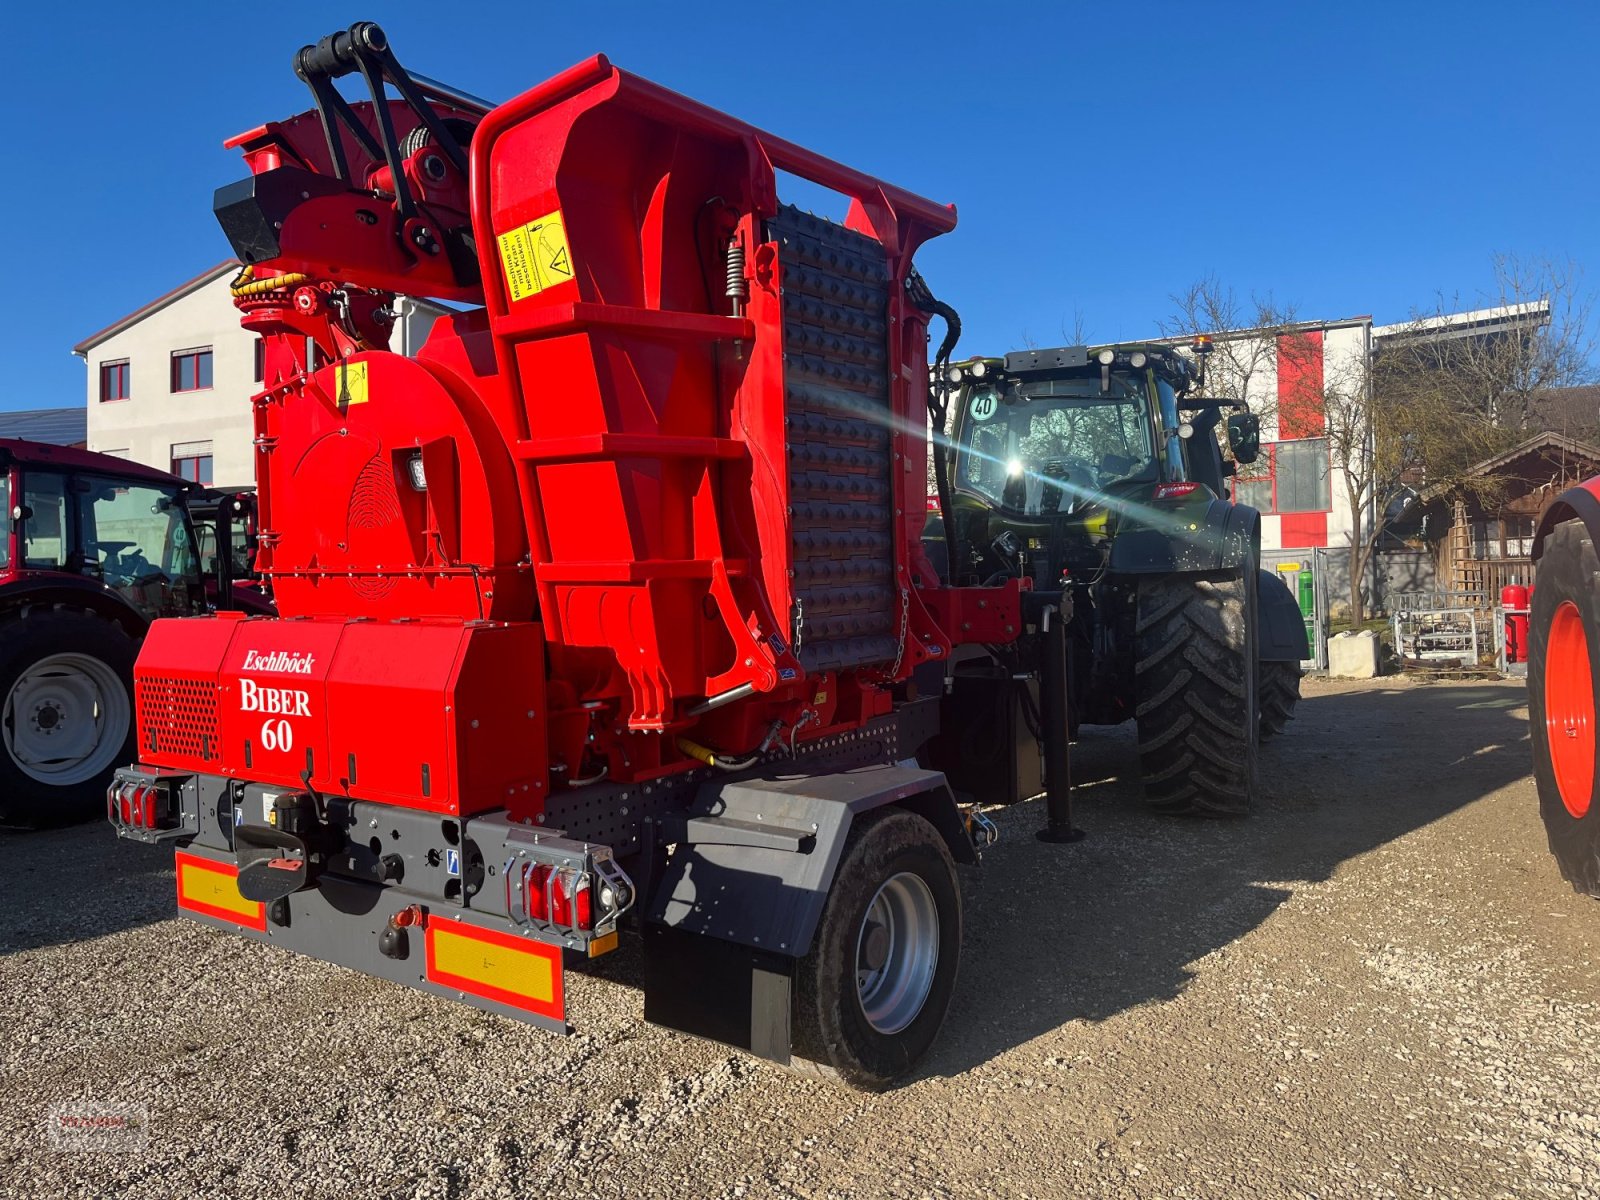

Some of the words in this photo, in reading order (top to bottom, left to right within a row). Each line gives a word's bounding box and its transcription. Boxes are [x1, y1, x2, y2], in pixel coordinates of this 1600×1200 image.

[511, 245, 519, 267] Kran
[514, 234, 532, 290] beschicken!
[507, 254, 520, 298] Maschine
[516, 270, 524, 284] mit
[975, 398, 991, 415] 40
[242, 650, 316, 674] Eschlböck
[239, 678, 312, 717] BIBER
[261, 719, 293, 753] 60
